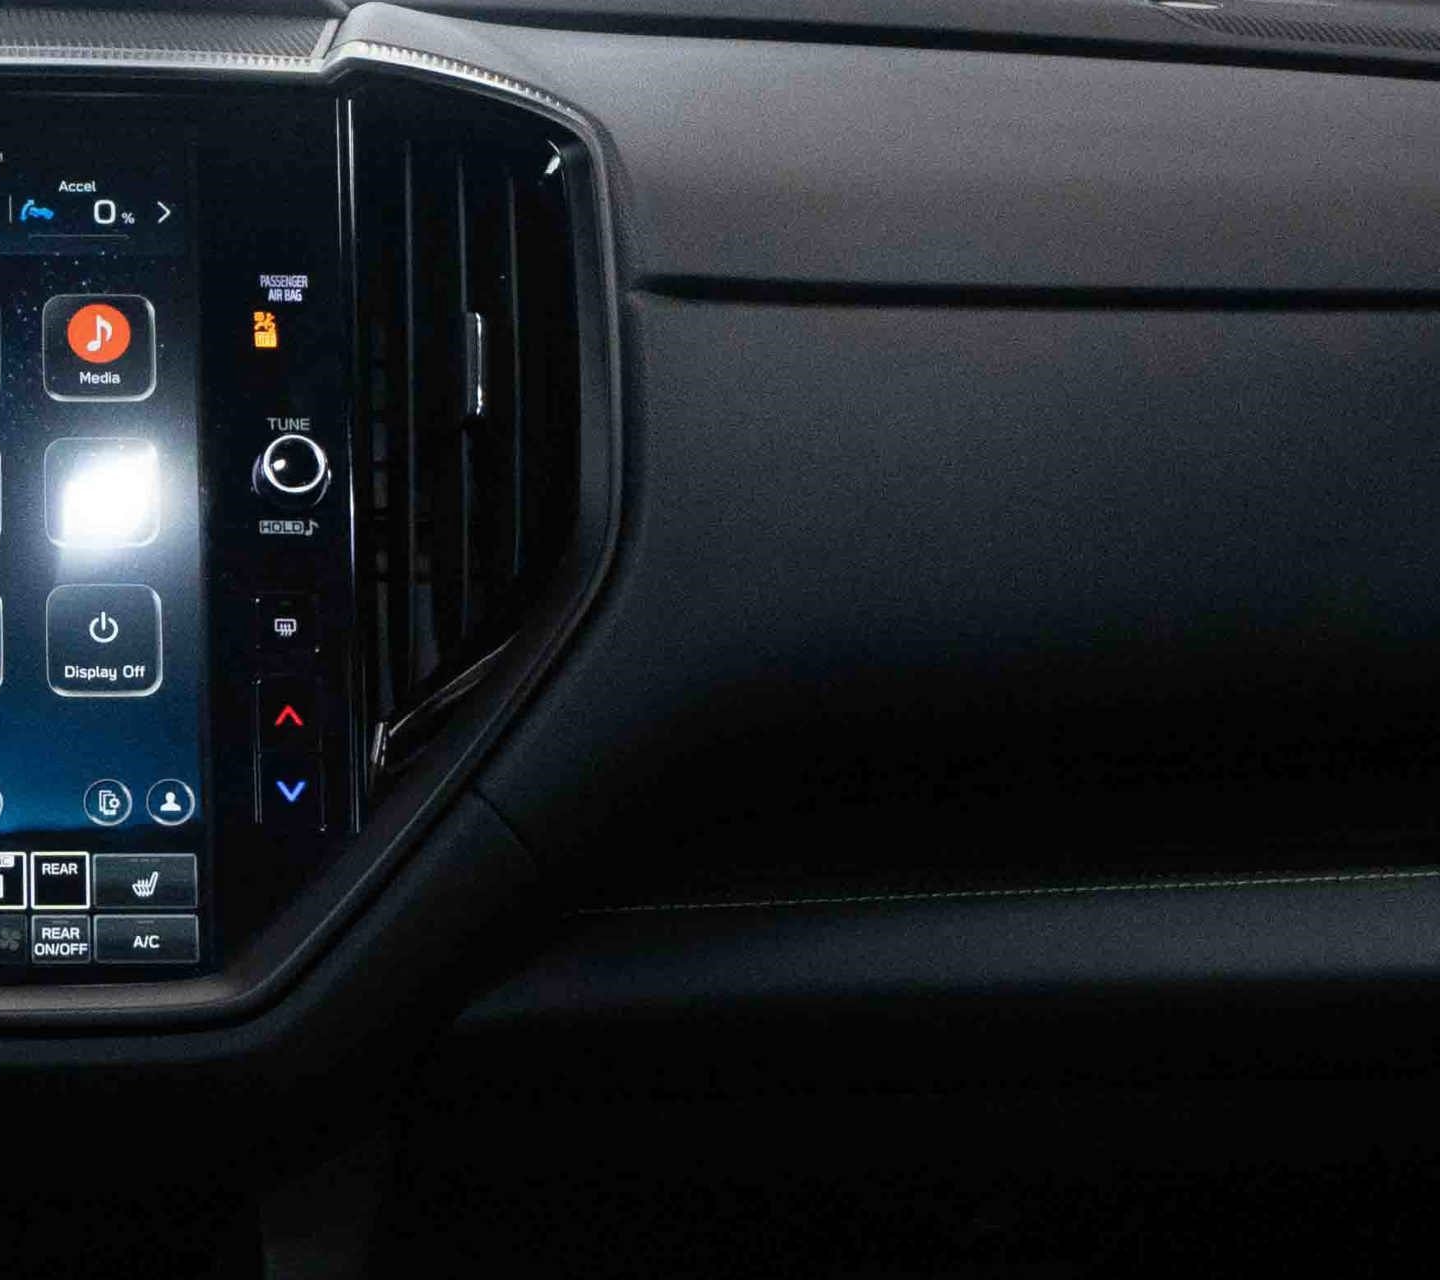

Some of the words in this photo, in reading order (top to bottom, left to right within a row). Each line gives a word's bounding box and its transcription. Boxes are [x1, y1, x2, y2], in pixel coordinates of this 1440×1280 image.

[58, 180, 97, 193] Accel
[93, 199, 117, 225] 0
[121, 212, 136, 225] %
[259, 274, 309, 289] PASSENGER
[267, 288, 283, 302] AIR
[283, 288, 303, 302] BAG
[79, 371, 121, 385] Media
[267, 417, 310, 431] TUNE
[64, 665, 118, 682] Display
[122, 664, 146, 679] Off
[41, 862, 79, 876] REAR
[41, 926, 81, 940] REAR
[132, 934, 160, 949] A/C
[33, 942, 89, 956] ON/OFF
